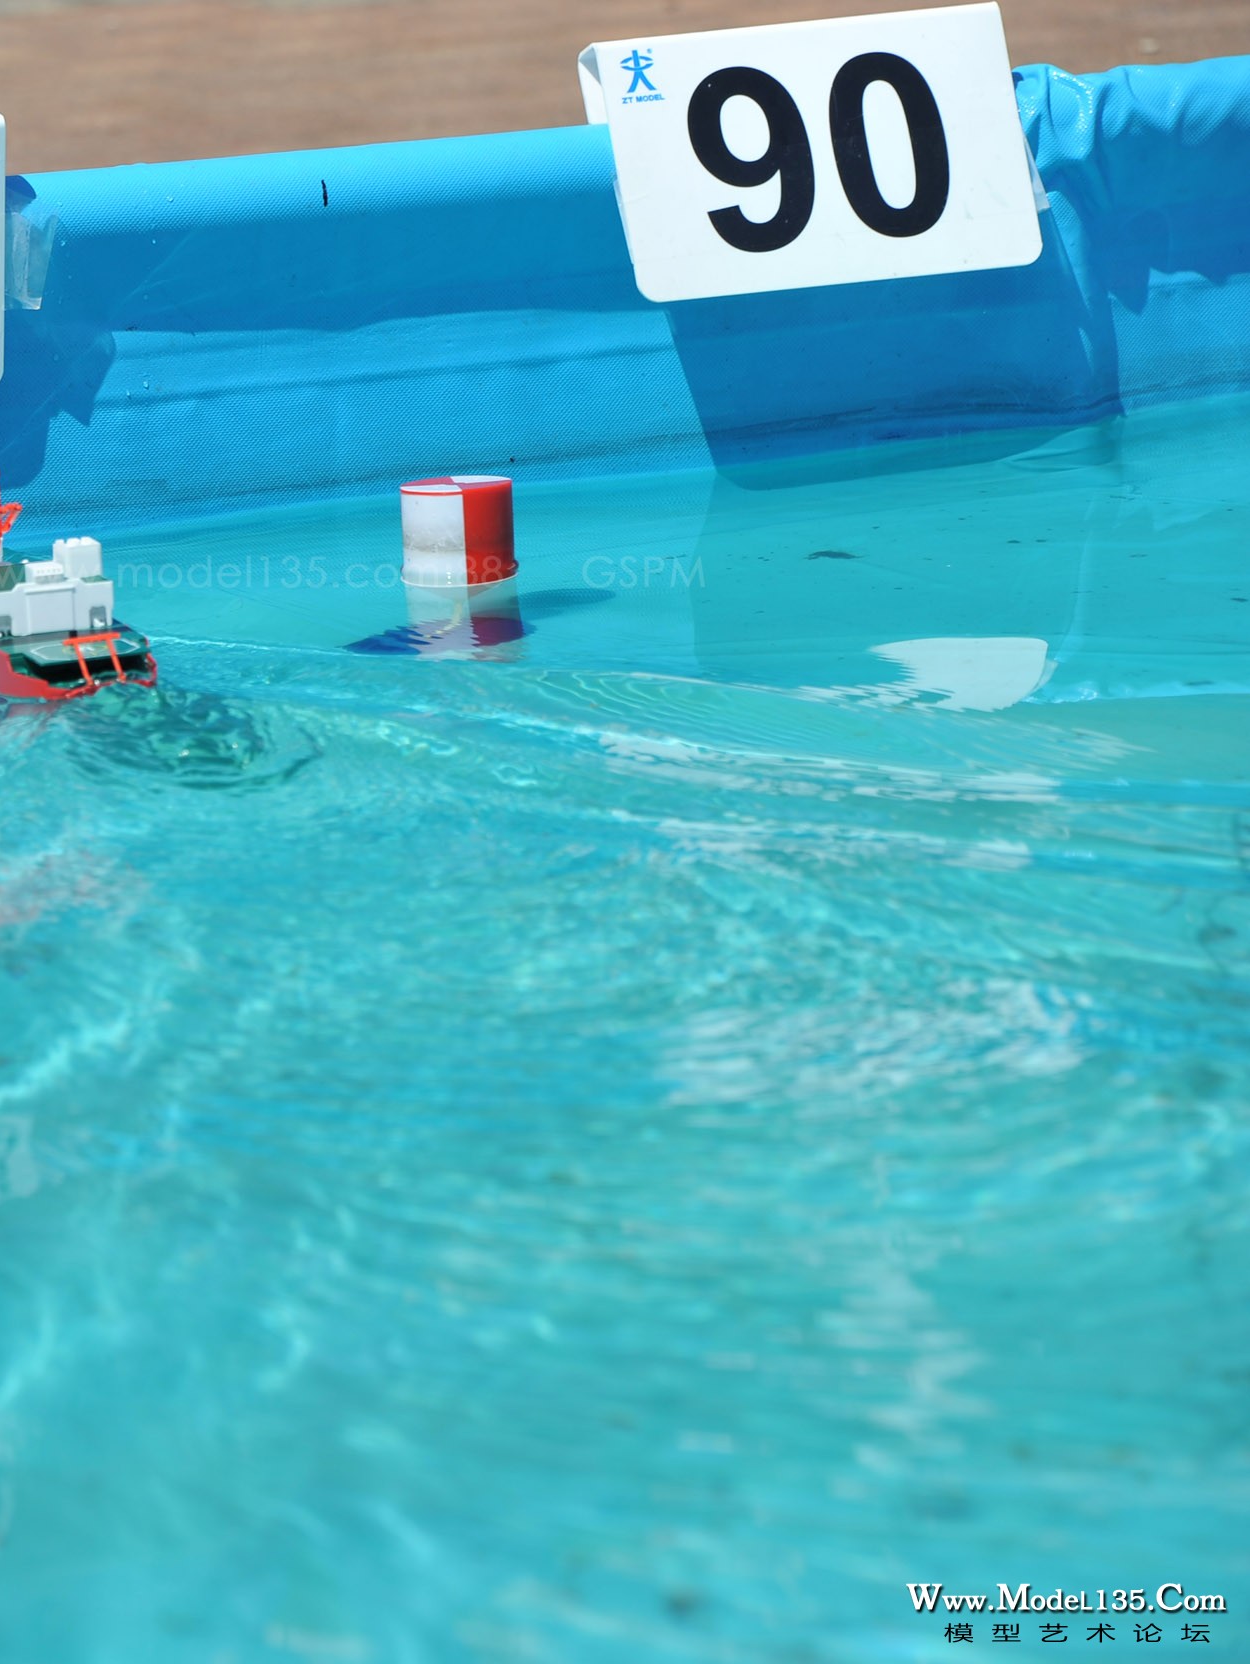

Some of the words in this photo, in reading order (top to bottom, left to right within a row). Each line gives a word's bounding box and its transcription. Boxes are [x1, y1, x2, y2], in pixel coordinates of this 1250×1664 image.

[622, 96, 633, 105] ZT
[635, 93, 666, 103] MODEL
[687, 51, 950, 253] 90
